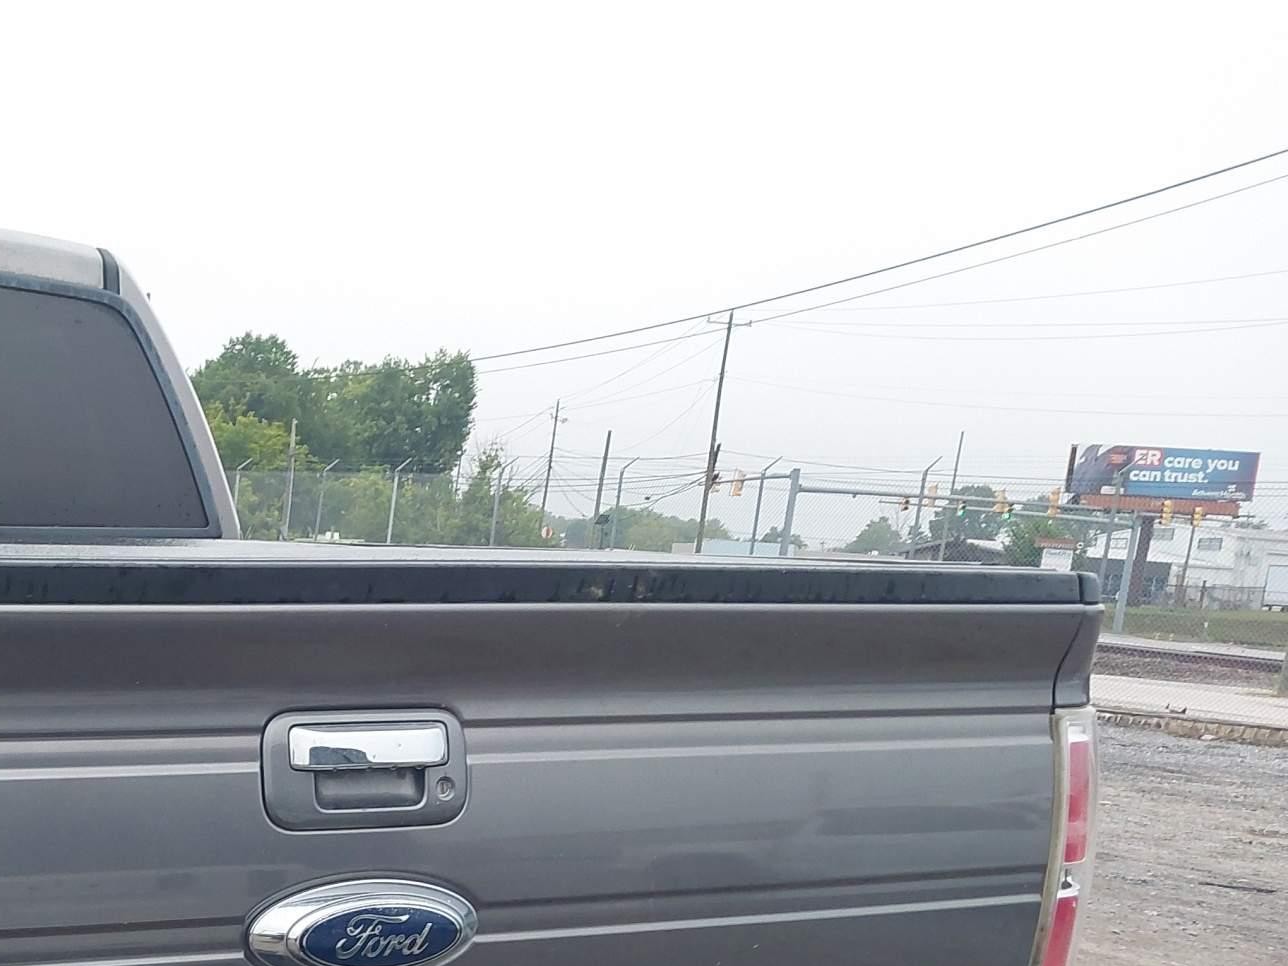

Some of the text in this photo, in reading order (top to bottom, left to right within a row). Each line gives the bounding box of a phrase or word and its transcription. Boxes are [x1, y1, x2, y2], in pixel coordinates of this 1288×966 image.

[1134, 449, 1240, 473] ER care you
[1129, 468, 1209, 484] can trust.
[335, 913, 433, 960] Ford
